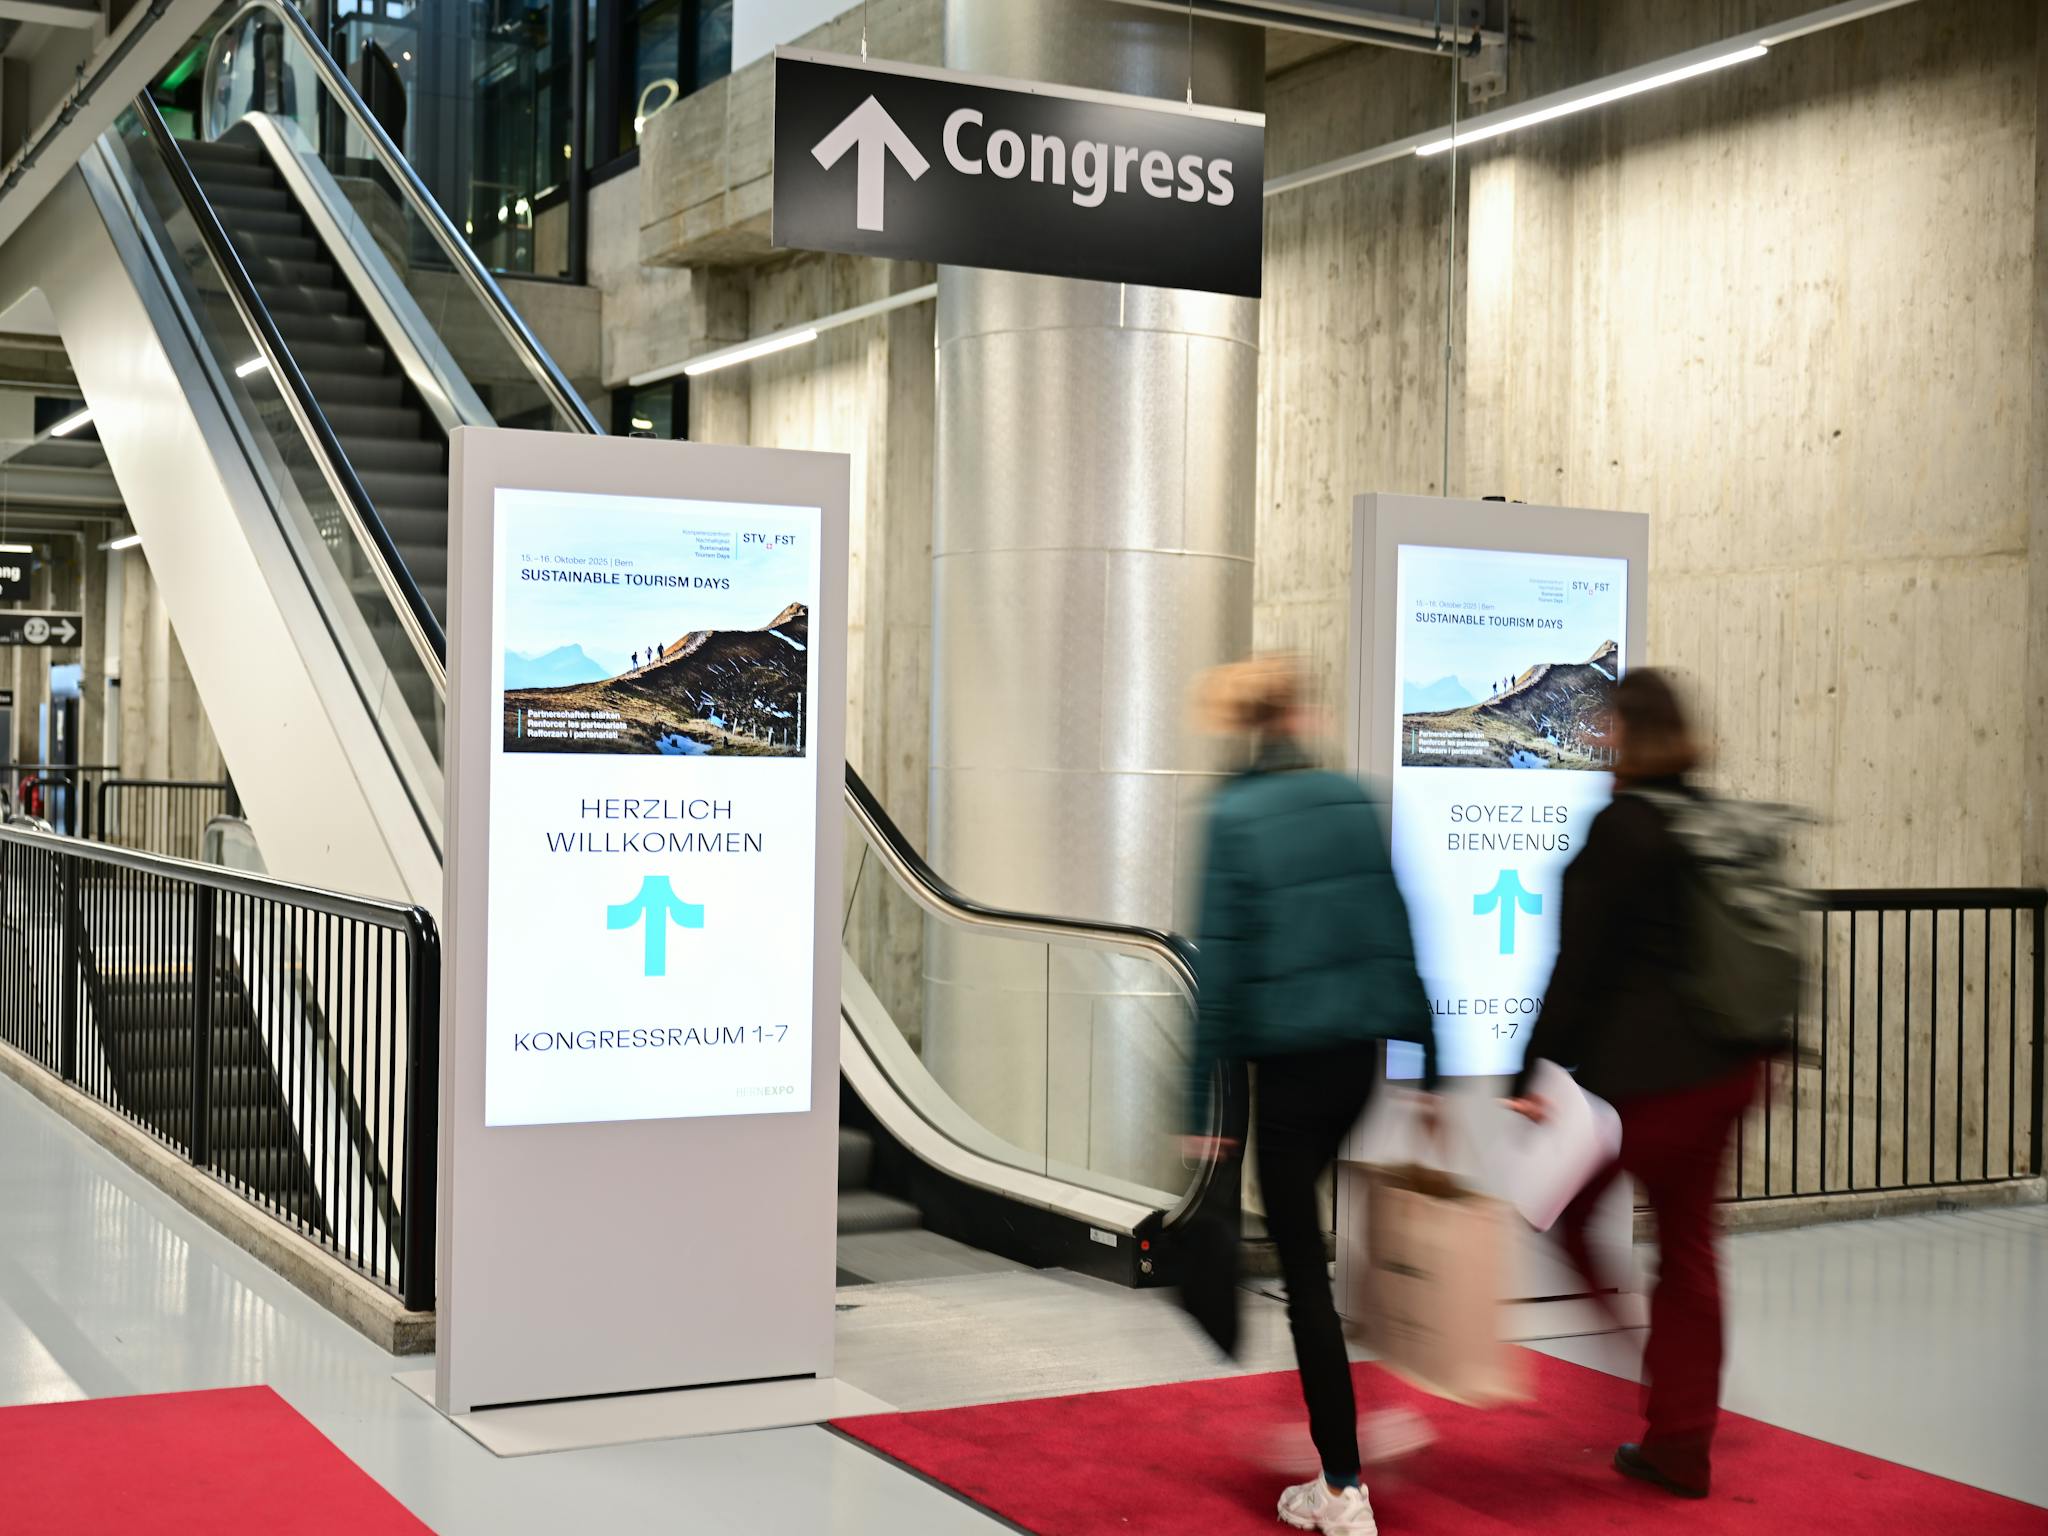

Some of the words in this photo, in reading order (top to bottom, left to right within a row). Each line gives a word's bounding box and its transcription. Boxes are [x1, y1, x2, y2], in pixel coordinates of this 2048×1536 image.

[942, 107, 1235, 208] Congress
[743, 533, 766, 543] STV
[774, 535, 796, 545] FST
[554, 555, 586, 565] Oktober
[588, 557, 608, 566] 2025
[614, 558, 634, 567] Bern
[521, 568, 620, 585] SUSTAINABLE
[624, 573, 689, 588] TOURISM
[694, 577, 730, 590] DAYS
[1572, 581, 1589, 590] STV
[1594, 582, 1610, 592] FST
[1416, 612, 1485, 626] SUSTAINABLE
[1488, 616, 1534, 628] TOURISM
[1537, 618, 1563, 629] DAYS
[528, 709, 590, 719] Partnerschaften
[528, 719, 566, 728] Renforcer
[580, 721, 627, 730] partenariats
[528, 729, 568, 738] Rafforzare
[574, 730, 618, 739] partenariati
[581, 799, 731, 819] HERZLICH
[1451, 804, 1523, 822] SOYEZ
[1531, 805, 1568, 823] LES
[546, 832, 762, 852] WILLKOMMEN
[1448, 833, 1570, 851] BIENVENUS
[1424, 999, 1468, 1015] ALLE
[1474, 998, 1498, 1015] DE
[1504, 997, 1545, 1014] CON
[514, 1025, 744, 1051] KONGRESSRAUM
[1491, 1023, 1519, 1039] 1-7
